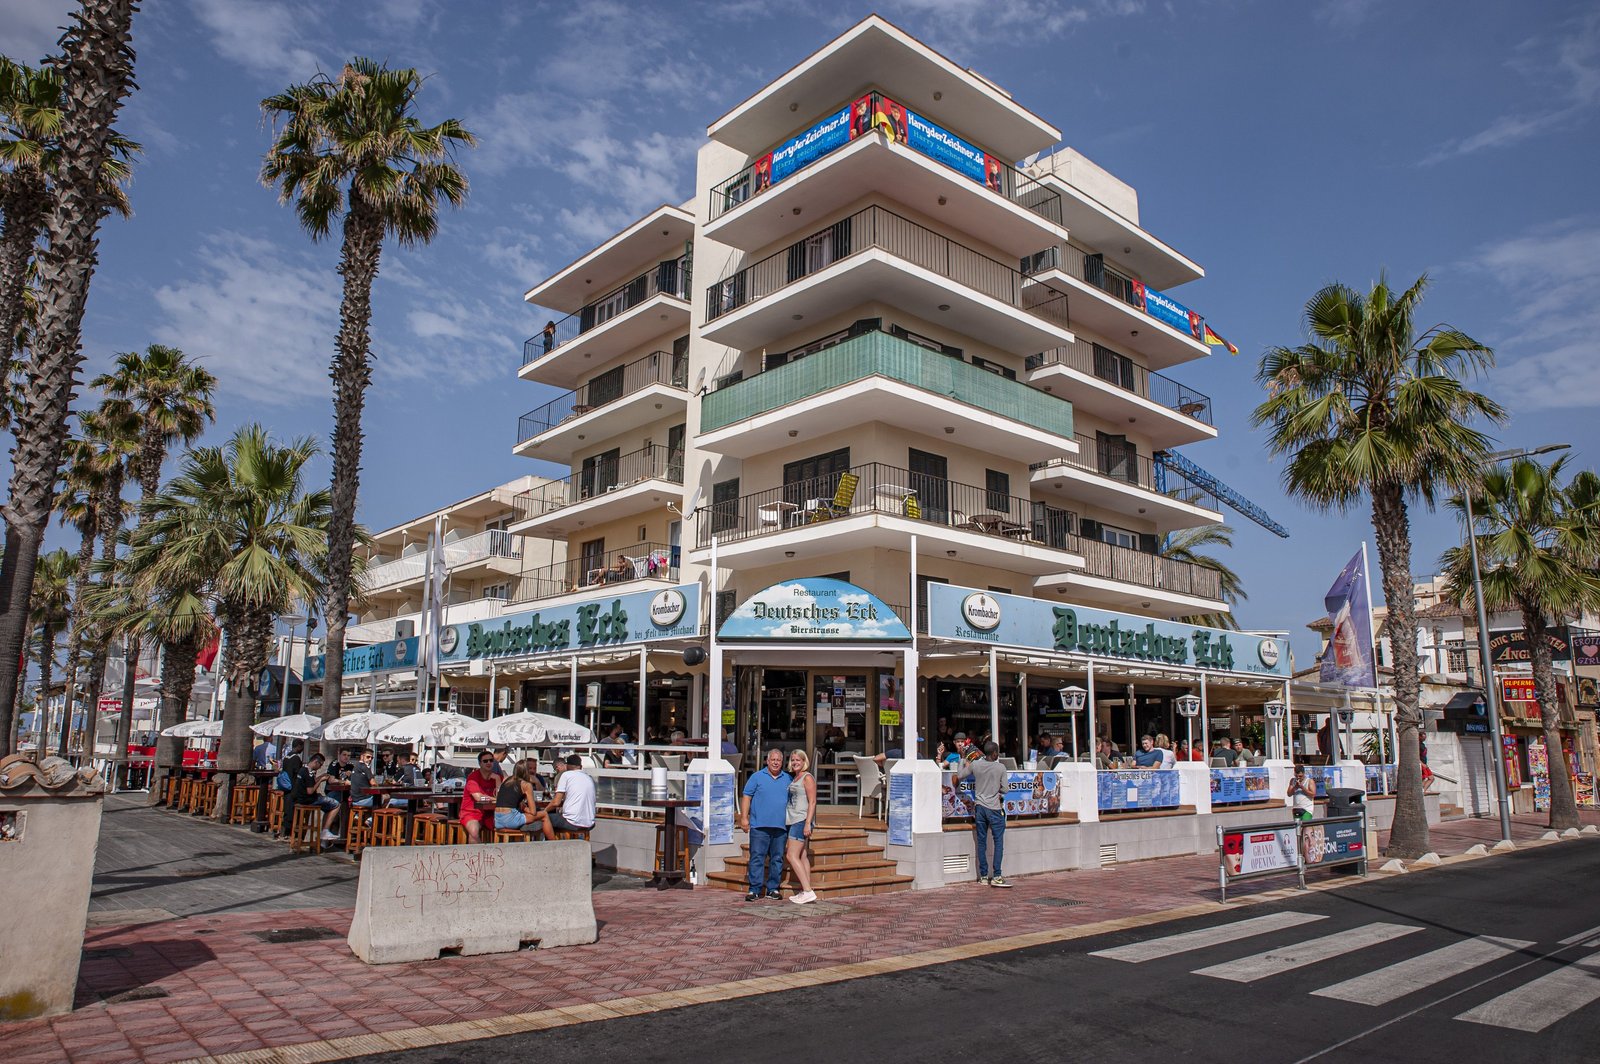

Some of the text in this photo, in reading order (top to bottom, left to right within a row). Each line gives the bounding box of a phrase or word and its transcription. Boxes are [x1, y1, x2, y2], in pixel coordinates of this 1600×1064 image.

[772, 111, 850, 164] HarryderZeichner.de
[907, 113, 984, 166] HarryderZeichner.de
[793, 588, 837, 597] Restaurant
[653, 602, 680, 615] Krombacher
[753, 602, 879, 624] Deutsches Eck
[968, 604, 999, 620] Krombacher
[577, 599, 629, 645] Eck
[790, 624, 840, 635] Bierstrasse
[955, 625, 1000, 642] Restaurante
[1052, 606, 1235, 671] Deutsches Eck
[1574, 637, 1600, 646] EROTI
[1549, 636, 1568, 651] TER
[1008, 780, 1039, 791] HSTÜCK
